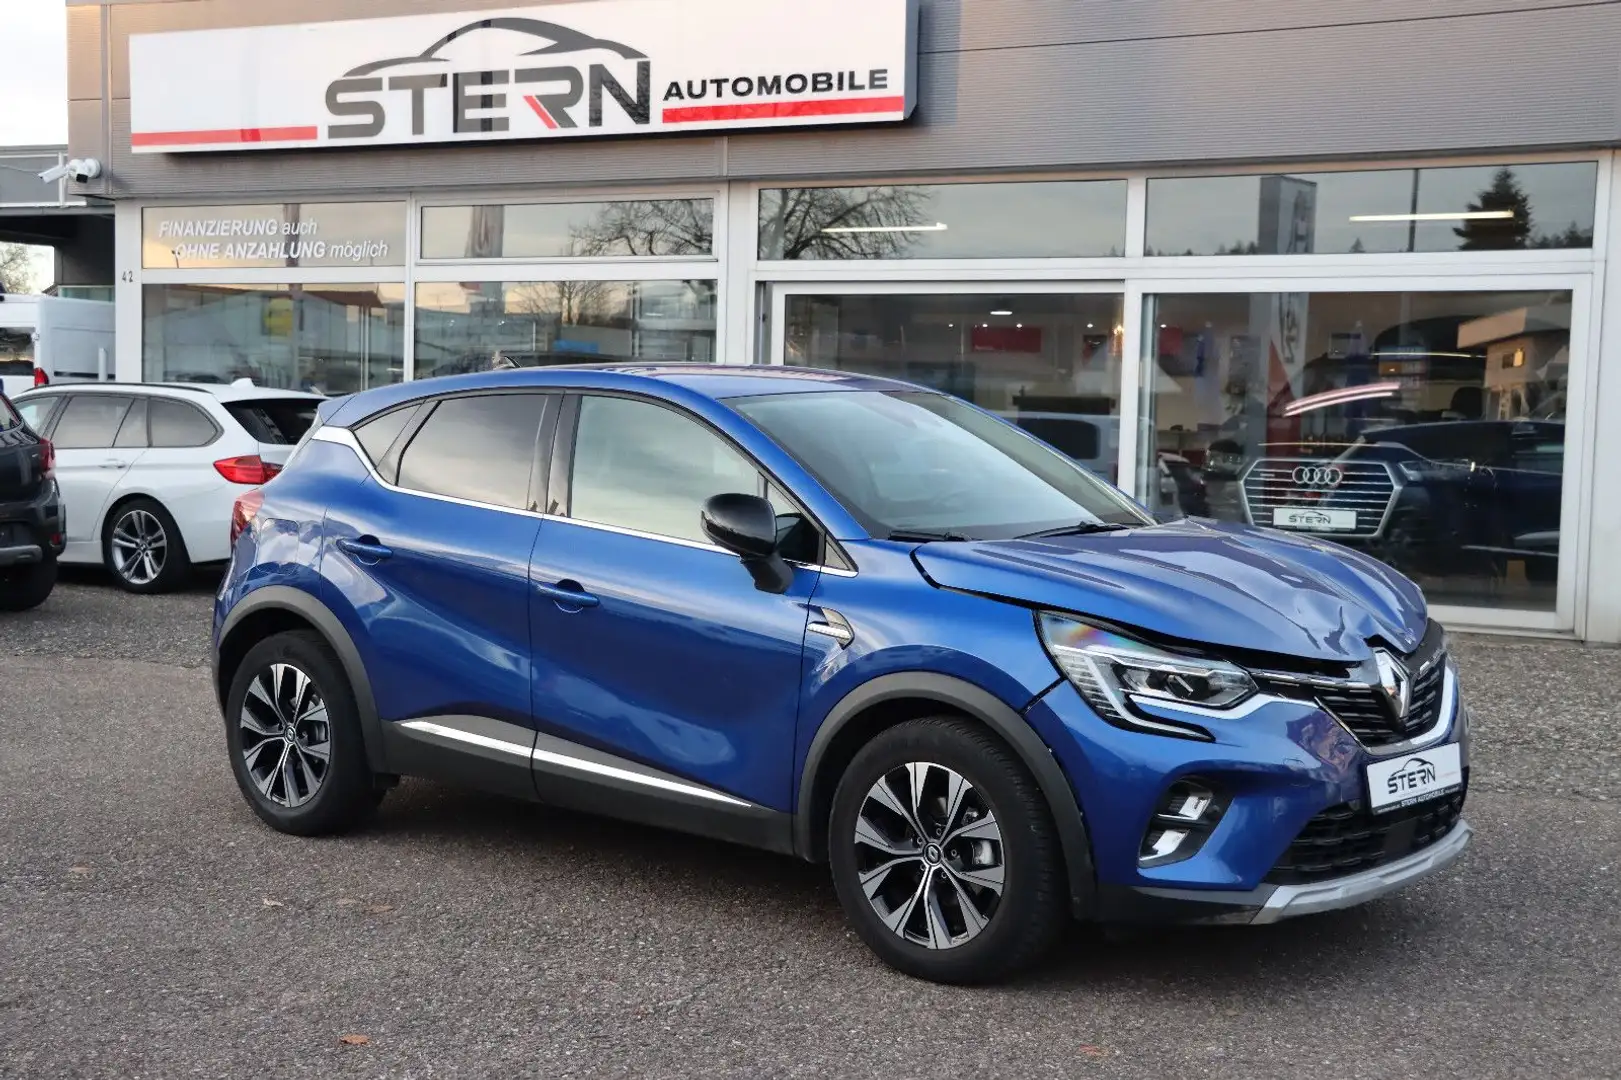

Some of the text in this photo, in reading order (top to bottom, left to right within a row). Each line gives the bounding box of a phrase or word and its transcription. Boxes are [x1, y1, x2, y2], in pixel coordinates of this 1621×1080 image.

[325, 61, 888, 139] STERN AUTOMOBILE
[159, 218, 317, 237] FINANZIERUNG auch
[174, 240, 388, 261] OHNE ANZAHLUNG möglich
[121, 270, 134, 283] 42
[1289, 515, 1331, 524] STERN
[1387, 767, 1436, 794] STERN
